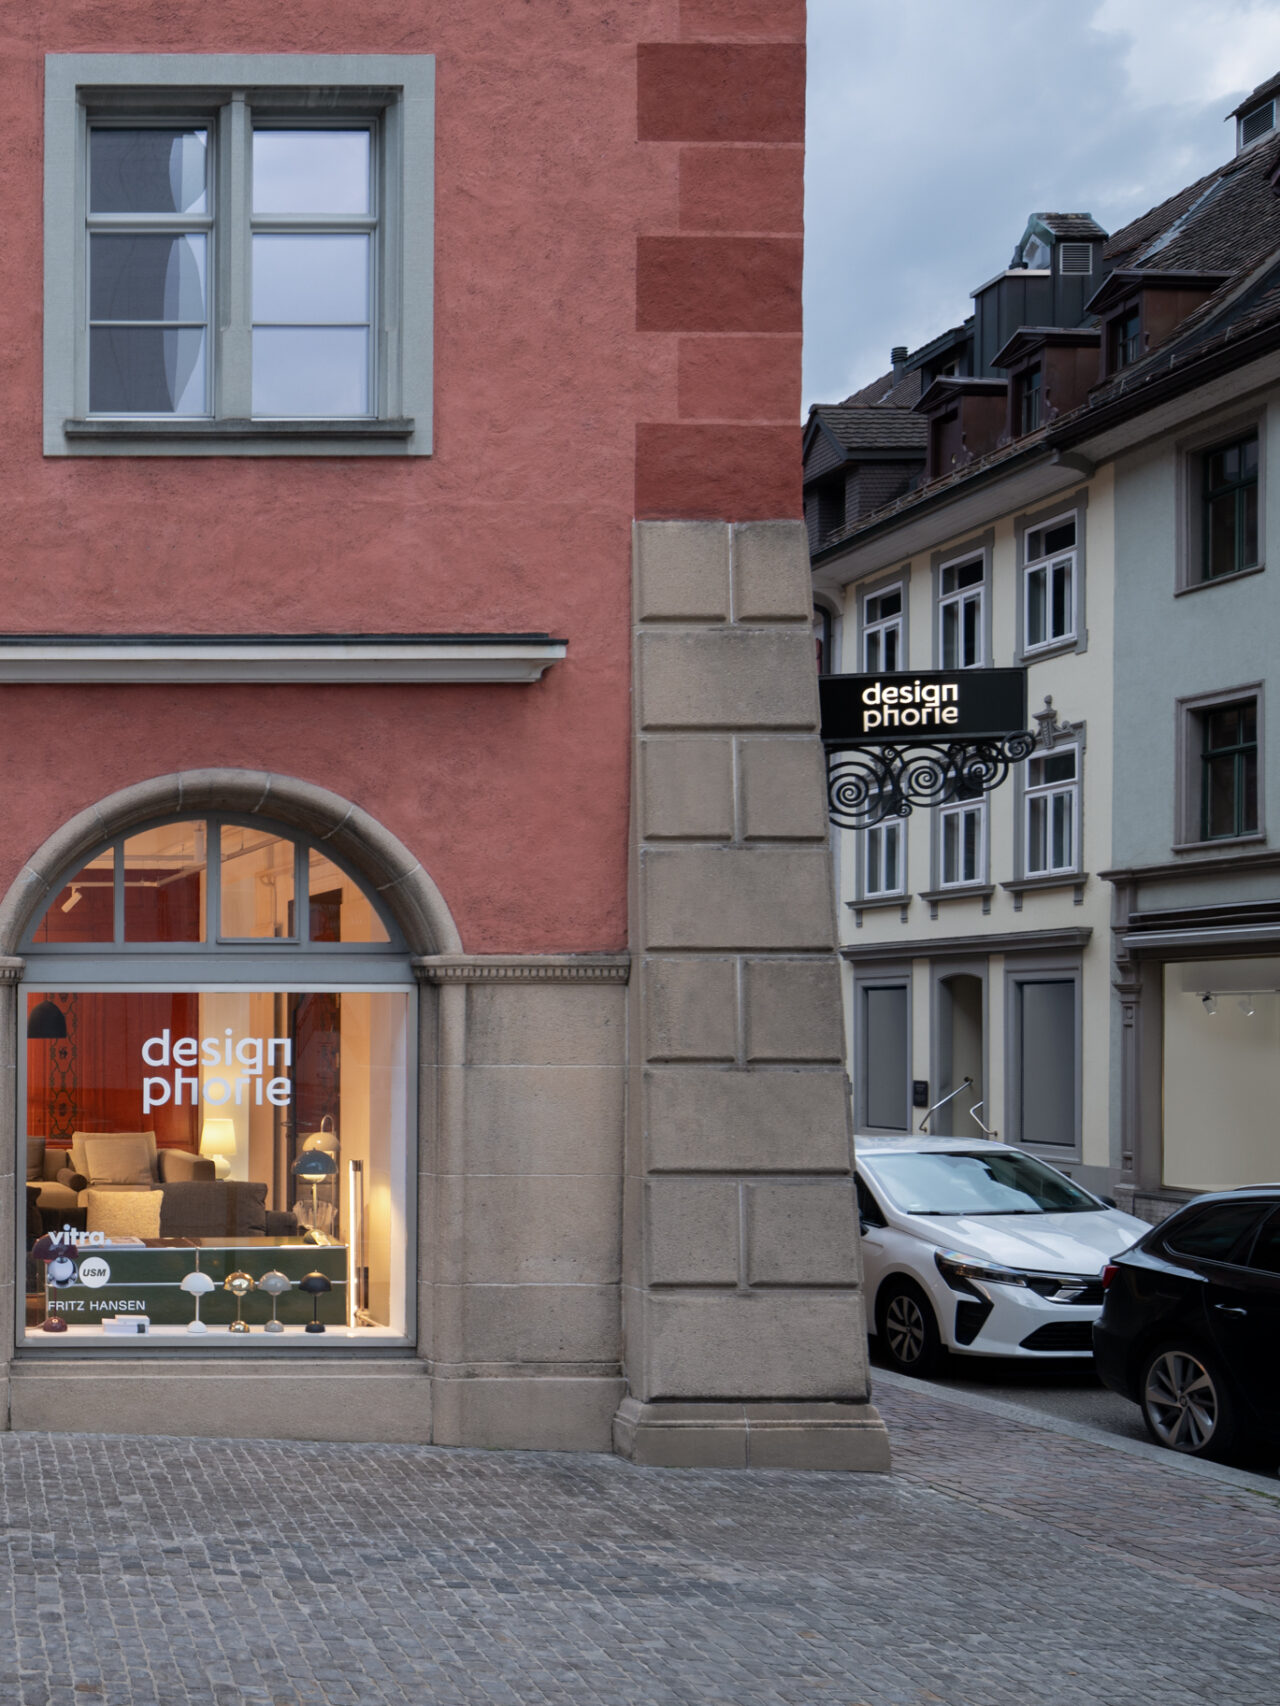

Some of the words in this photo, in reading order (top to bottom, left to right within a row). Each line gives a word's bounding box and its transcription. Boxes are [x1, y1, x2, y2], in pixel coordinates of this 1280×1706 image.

[862, 680, 959, 707] design
[863, 704, 959, 732] phorie
[141, 1028, 292, 1075] design
[143, 1068, 292, 1114] phorie
[48, 1223, 112, 1246] vitra.
[83, 1268, 107, 1277] USM
[48, 1300, 85, 1311] FRITZ
[89, 1300, 146, 1311] HANSEN
